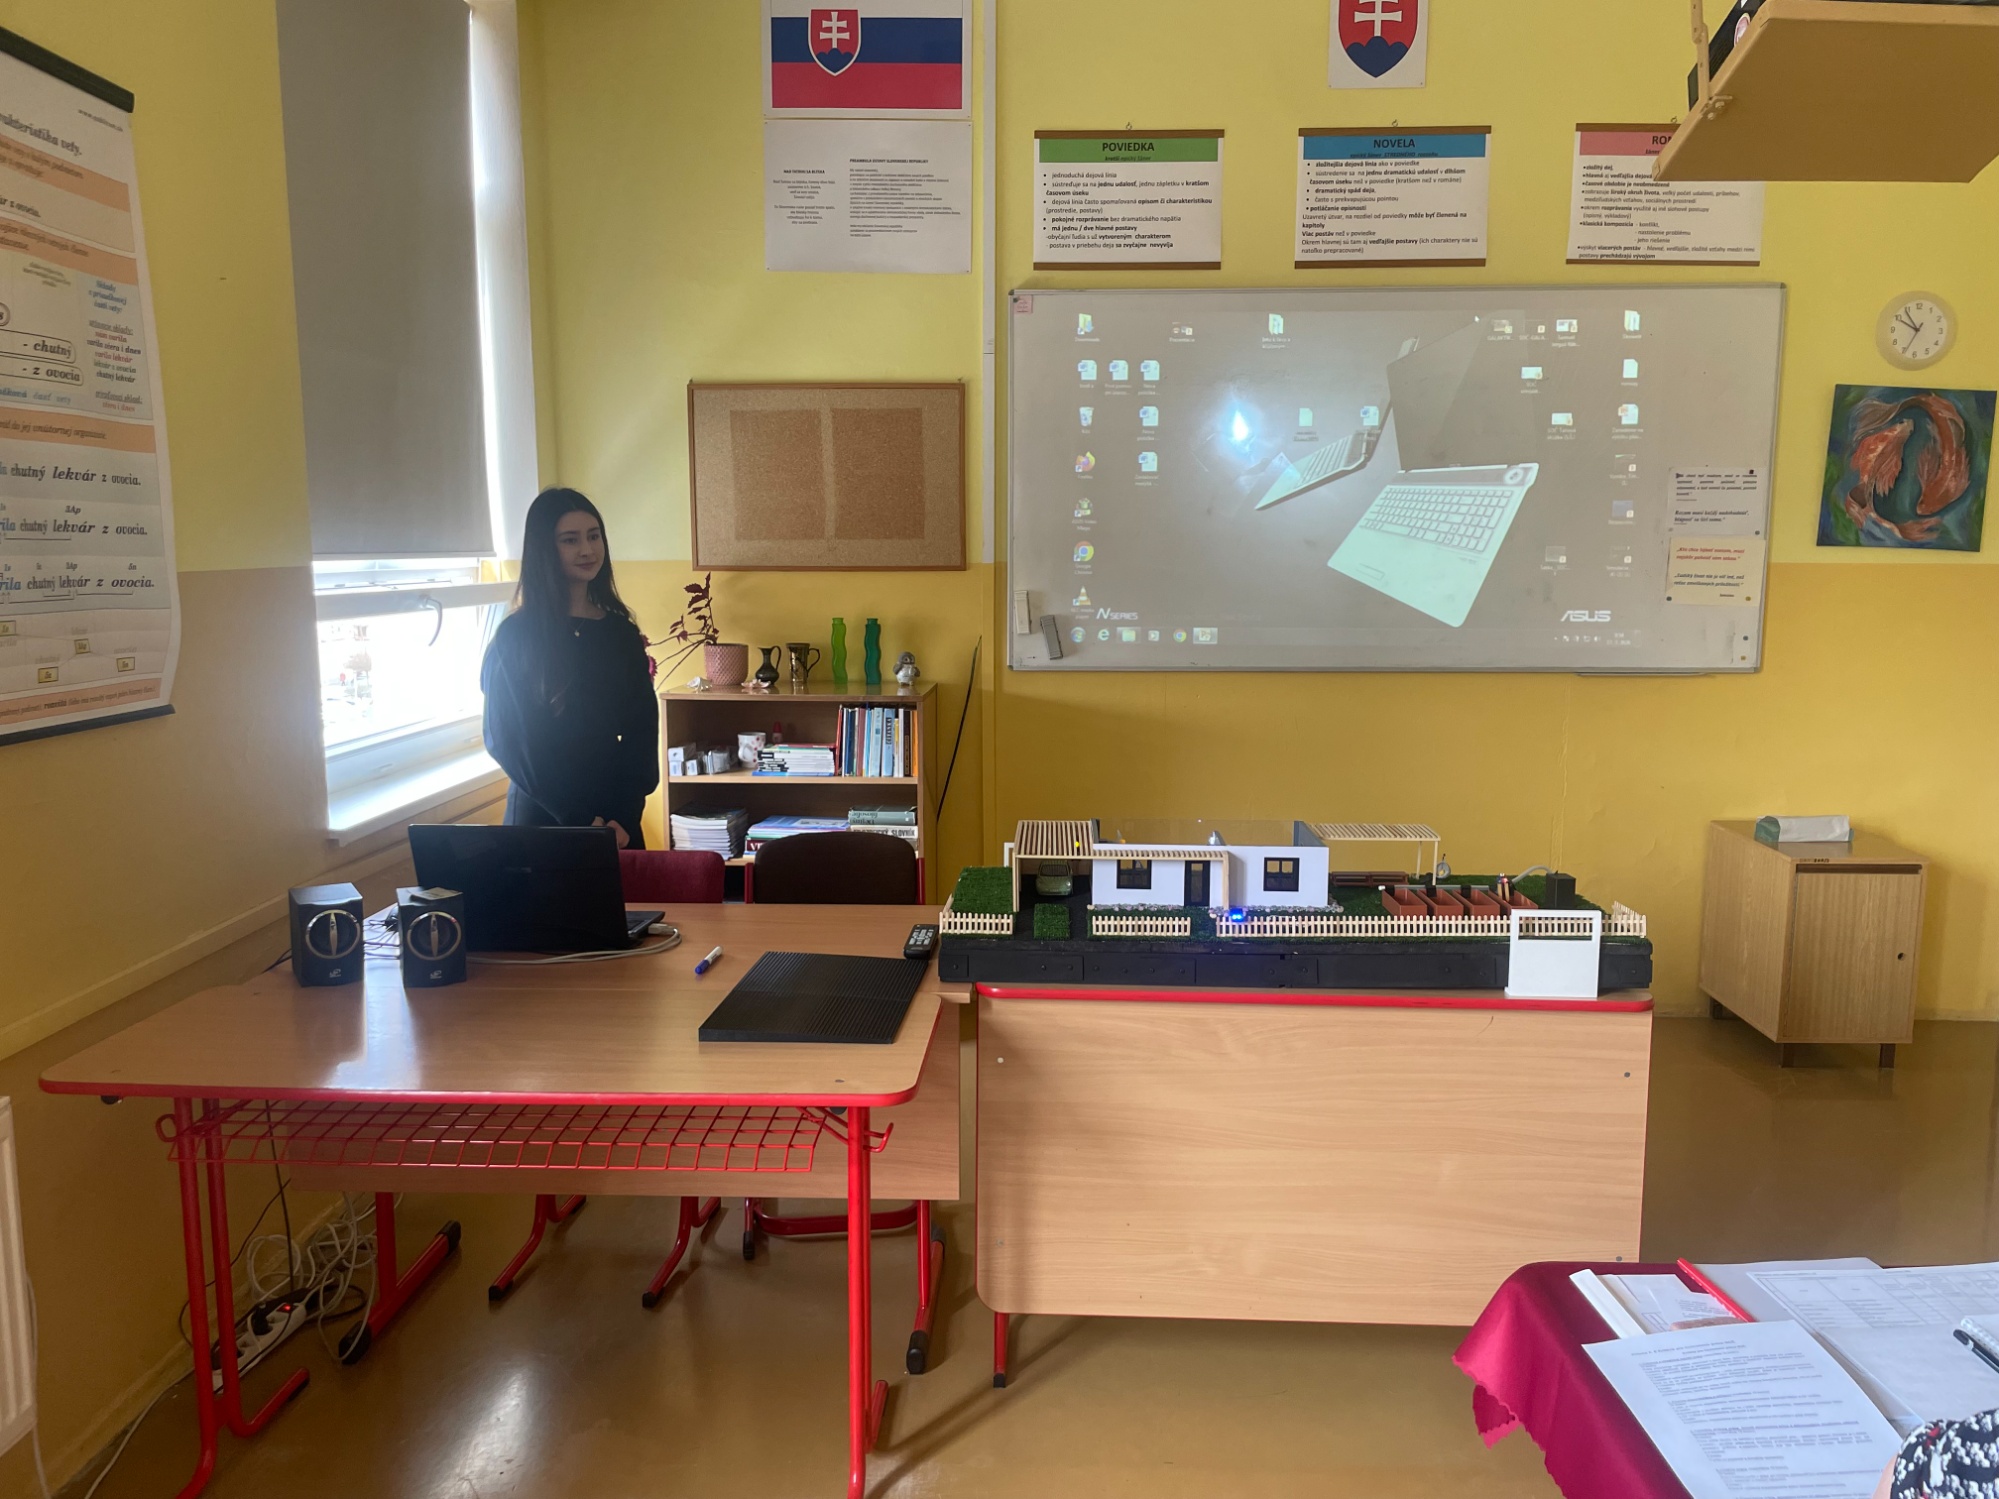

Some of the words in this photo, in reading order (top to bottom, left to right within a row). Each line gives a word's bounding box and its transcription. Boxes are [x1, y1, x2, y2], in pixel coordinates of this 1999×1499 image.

[1102, 142, 1154, 152] POVIEDKA
[1374, 139, 1415, 148] NOVELA
[33, 340, 72, 359] chutný
[46, 369, 80, 382] ovocia
[10, 463, 45, 481] chutný
[52, 466, 96, 482] lekvár
[112, 474, 141, 486] ovocia.
[20, 518, 48, 537] chutný
[53, 520, 95, 533] lekvár
[102, 525, 108, 534] z
[116, 523, 148, 535] ovocia.
[27, 577, 56, 591] chutný
[59, 576, 90, 588] lekvár
[96, 578, 104, 587] z
[111, 576, 155, 588] ovocia.
[1110, 612, 1138, 620] SERIES
[1560, 610, 1611, 622] ASUS
[892, 828, 915, 836] SLOVNÍK
